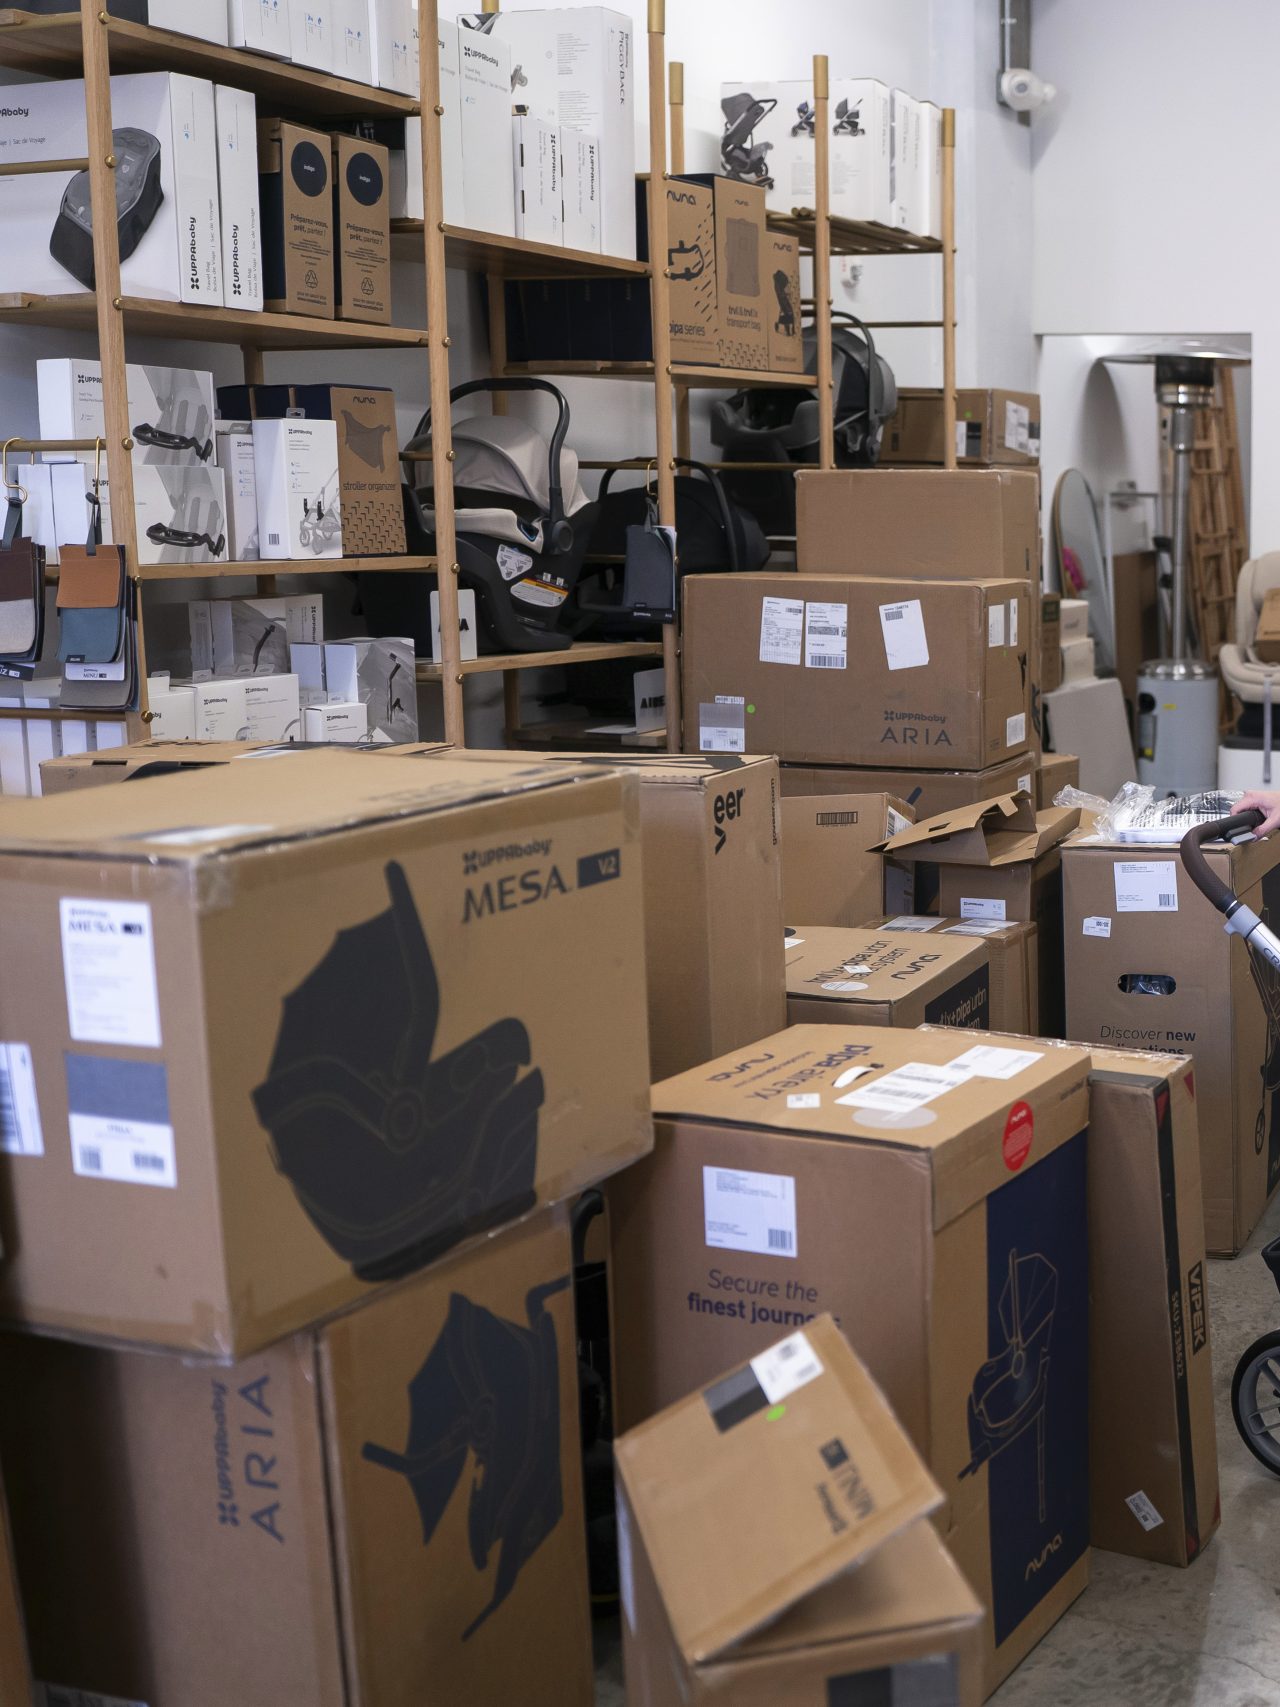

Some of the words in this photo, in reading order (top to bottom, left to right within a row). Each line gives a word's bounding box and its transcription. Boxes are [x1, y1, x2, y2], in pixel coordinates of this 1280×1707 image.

[667, 189, 697, 206] nuna
[189, 217, 198, 276] UPPAbaby
[231, 224, 239, 282] UPPAbaby
[773, 242, 792, 252] nuna
[684, 323, 706, 336] series
[352, 396, 376, 405] nuna
[343, 481, 367, 491] stroller
[368, 481, 396, 493] organizer
[895, 711, 946, 724] UPPAbaby
[880, 727, 952, 746] ARIA
[478, 839, 552, 868] UPPAbaby
[598, 855, 617, 876] V2
[462, 864, 568, 924] MESA
[890, 953, 943, 980] nuna
[956, 1000, 971, 1027] pipa
[971, 986, 987, 1010] urbn
[1100, 1025, 1162, 1040] Discover
[1166, 1031, 1196, 1041] new
[705, 1053, 775, 1083] nuna
[708, 1268, 779, 1298] Secure
[786, 1279, 818, 1303] the
[687, 1291, 746, 1319] finest
[238, 1374, 285, 1544] ARIA
[1024, 1533, 1063, 1582] nuna
